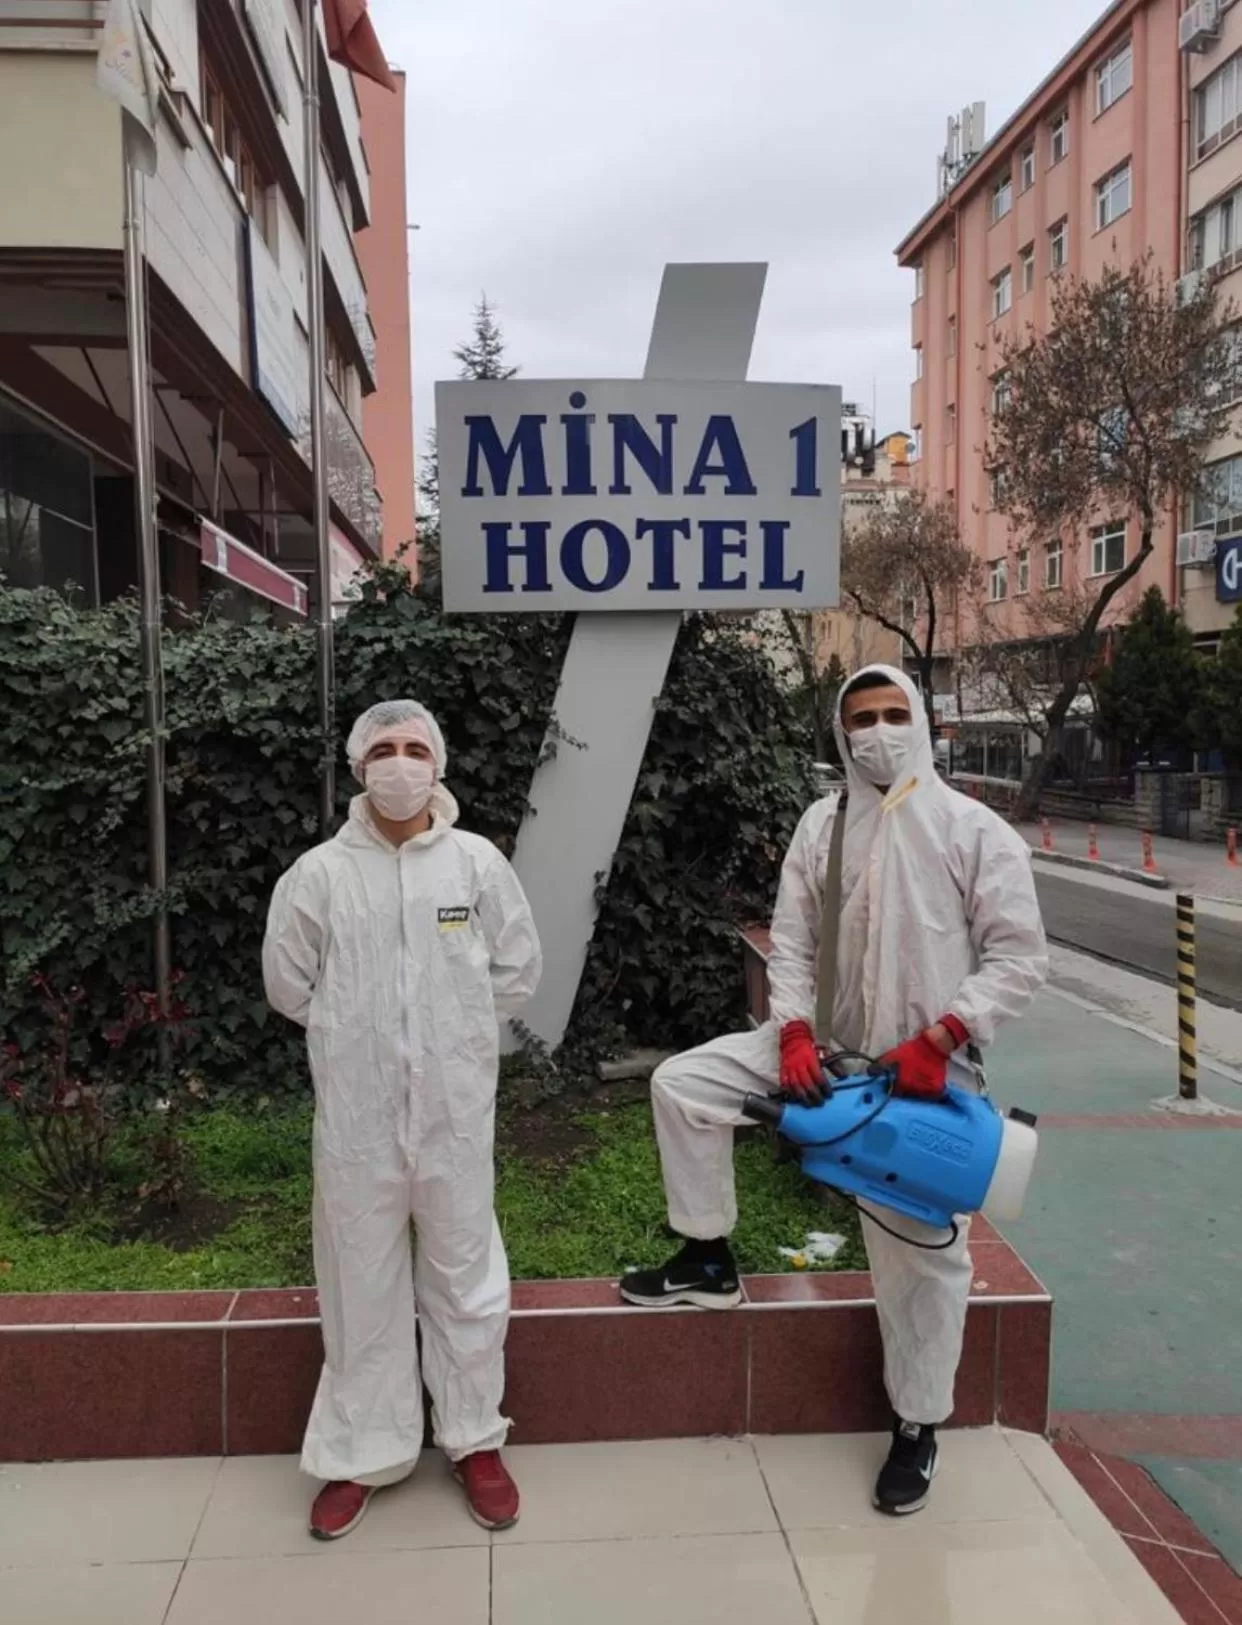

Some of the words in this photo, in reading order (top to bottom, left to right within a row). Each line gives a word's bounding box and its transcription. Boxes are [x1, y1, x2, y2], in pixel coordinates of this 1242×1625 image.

[461, 391, 758, 497] MİNA
[788, 416, 822, 497] 1
[481, 518, 804, 593] HOTEL
